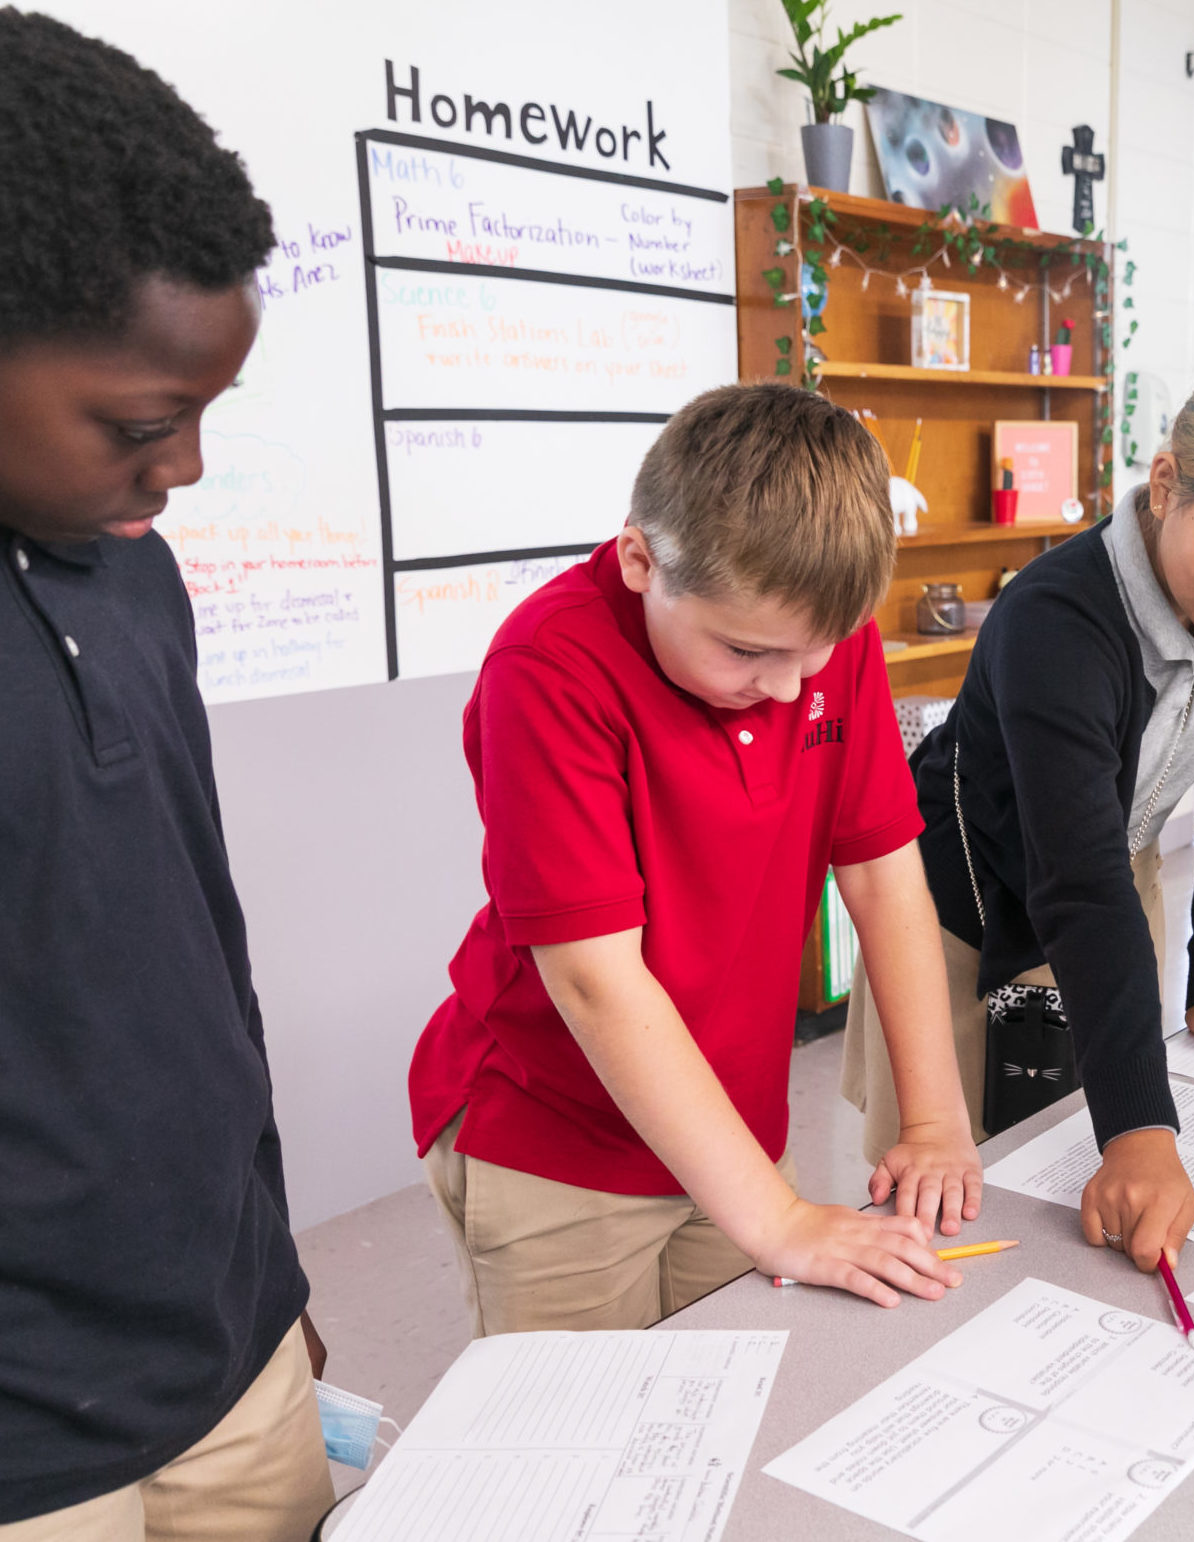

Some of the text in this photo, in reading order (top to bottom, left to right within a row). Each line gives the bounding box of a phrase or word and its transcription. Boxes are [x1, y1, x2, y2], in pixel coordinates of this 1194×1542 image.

[384, 58, 670, 171] Homework
[371, 146, 464, 190] Math 6
[393, 195, 458, 237] Prime
[467, 198, 600, 248] Factorization
[620, 203, 693, 236] Color by
[281, 240, 300, 258] to
[627, 232, 690, 253] Number
[380, 271, 497, 311] Science 6
[416, 313, 474, 342] Finish
[487, 315, 569, 345] Stations
[577, 318, 613, 348] Lab
[575, 360, 597, 373] on
[605, 361, 641, 386] your
[388, 425, 482, 455] Spanish 6
[227, 525, 249, 552] up
[256, 521, 278, 540] all
[185, 557, 216, 578] Stop
[221, 561, 236, 571] in
[225, 599, 243, 613] up
[251, 593, 270, 611] for
[397, 573, 481, 616] Spanish
[801, 717, 845, 753] uHi
